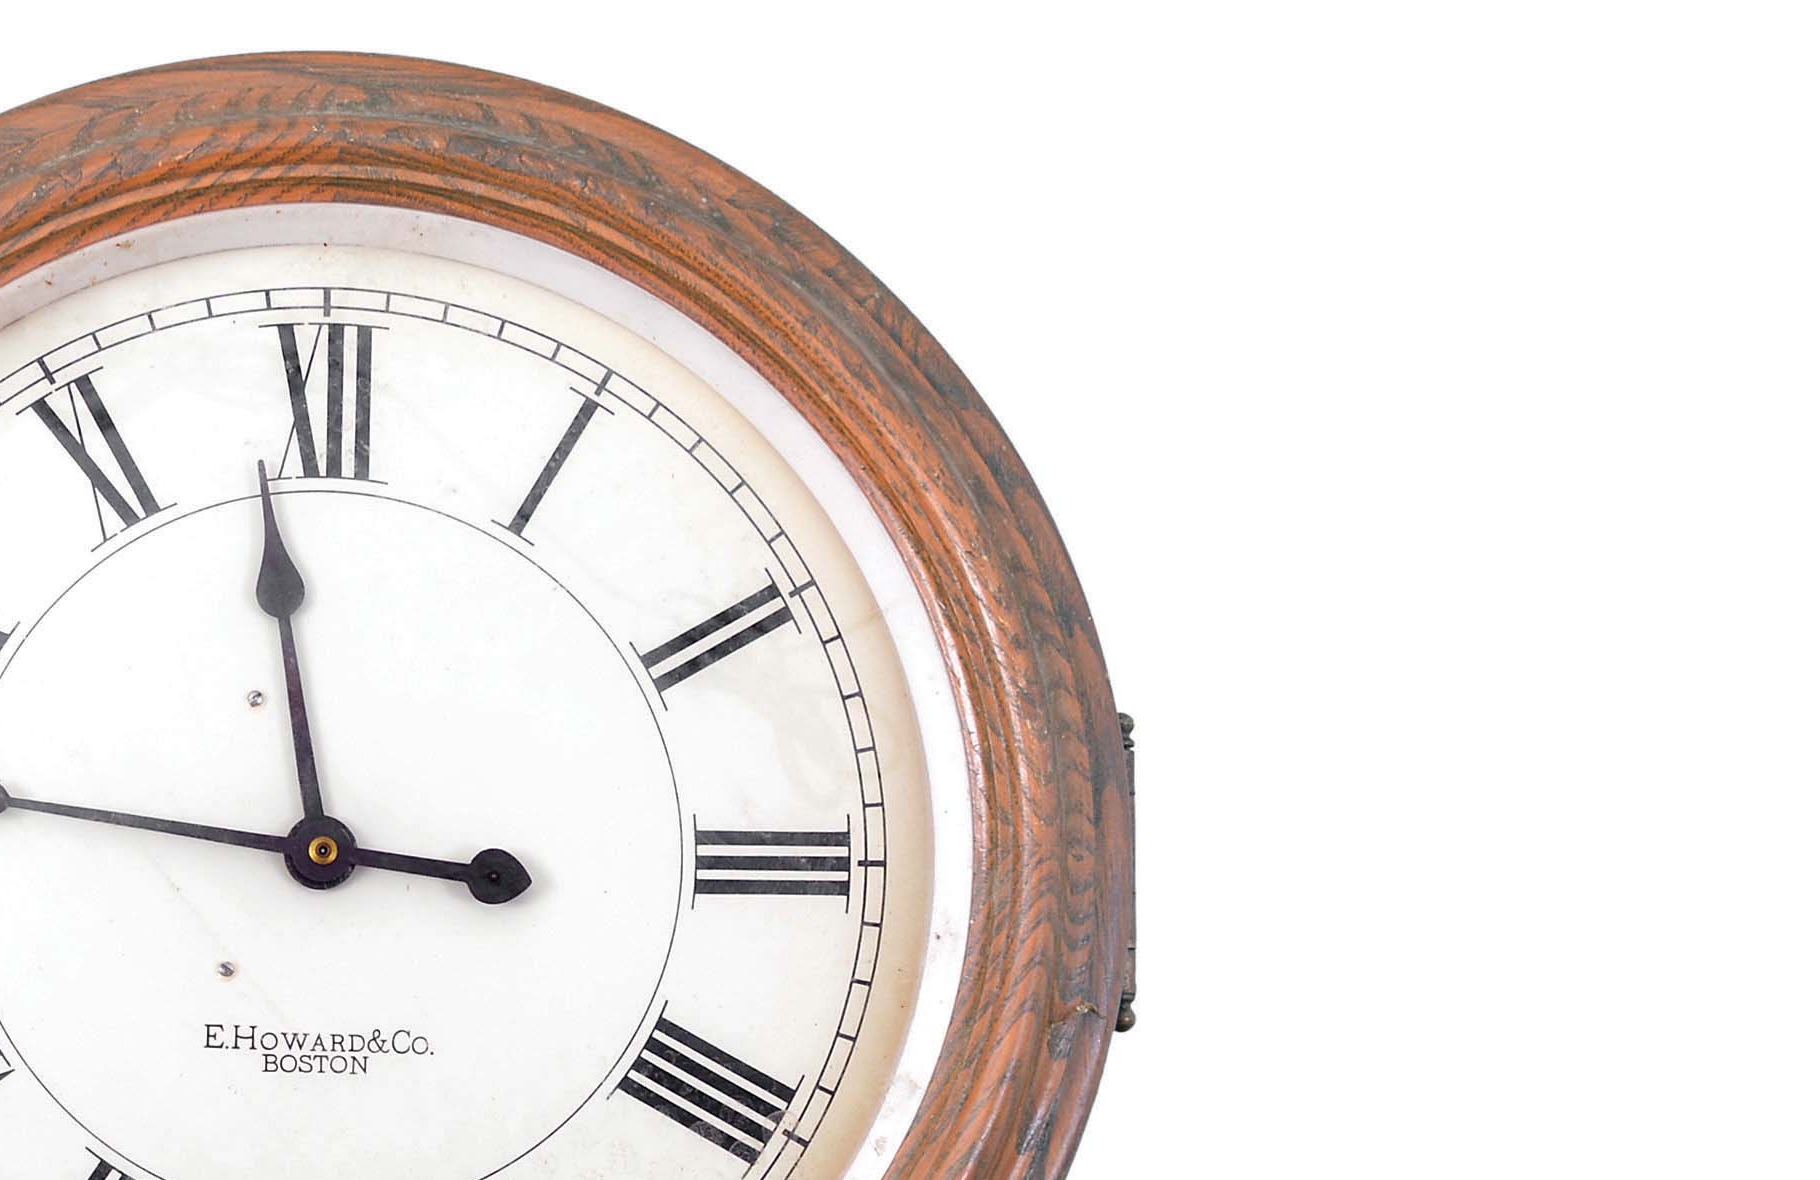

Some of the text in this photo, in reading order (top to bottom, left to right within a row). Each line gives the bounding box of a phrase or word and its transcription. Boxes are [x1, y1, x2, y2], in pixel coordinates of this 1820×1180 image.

[16, 366, 178, 552] XI
[264, 322, 389, 484] XII
[628, 567, 801, 710] II
[693, 813, 850, 910] III
[262, 1053, 369, 1074] BOSTON
